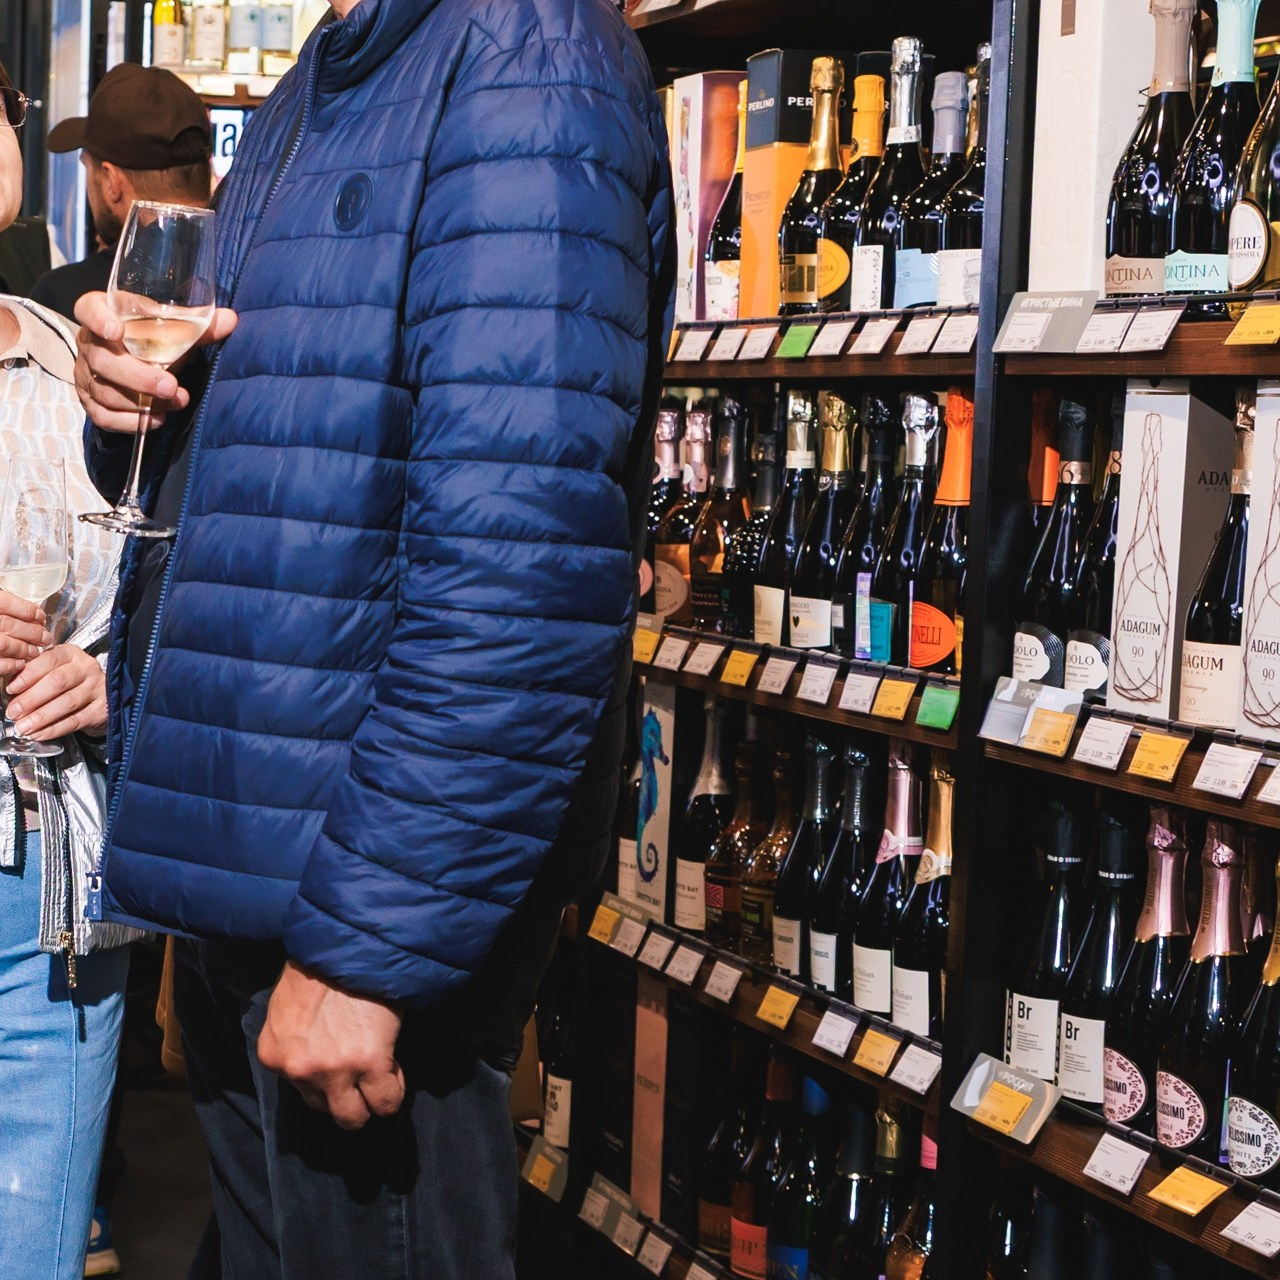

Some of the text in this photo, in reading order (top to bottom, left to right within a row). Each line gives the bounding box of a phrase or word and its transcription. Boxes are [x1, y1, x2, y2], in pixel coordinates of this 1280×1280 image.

[748, 97, 775, 112] PERLINO
[1021, 296, 1084, 309] ИГРИСТЫЕ ВИНА
[1110, 450, 1122, 474] 8
[1060, 462, 1074, 484] 6
[1197, 470, 1230, 486] ADA
[1120, 619, 1161, 636] ADAGUM
[1131, 645, 1145, 658] 90
[1262, 668, 1275, 681] 90
[1185, 696, 1196, 706] 90
[1018, 1001, 1032, 1020] Br
[1065, 1021, 1080, 1041] Br
[1244, 1231, 1257, 1240] 714
